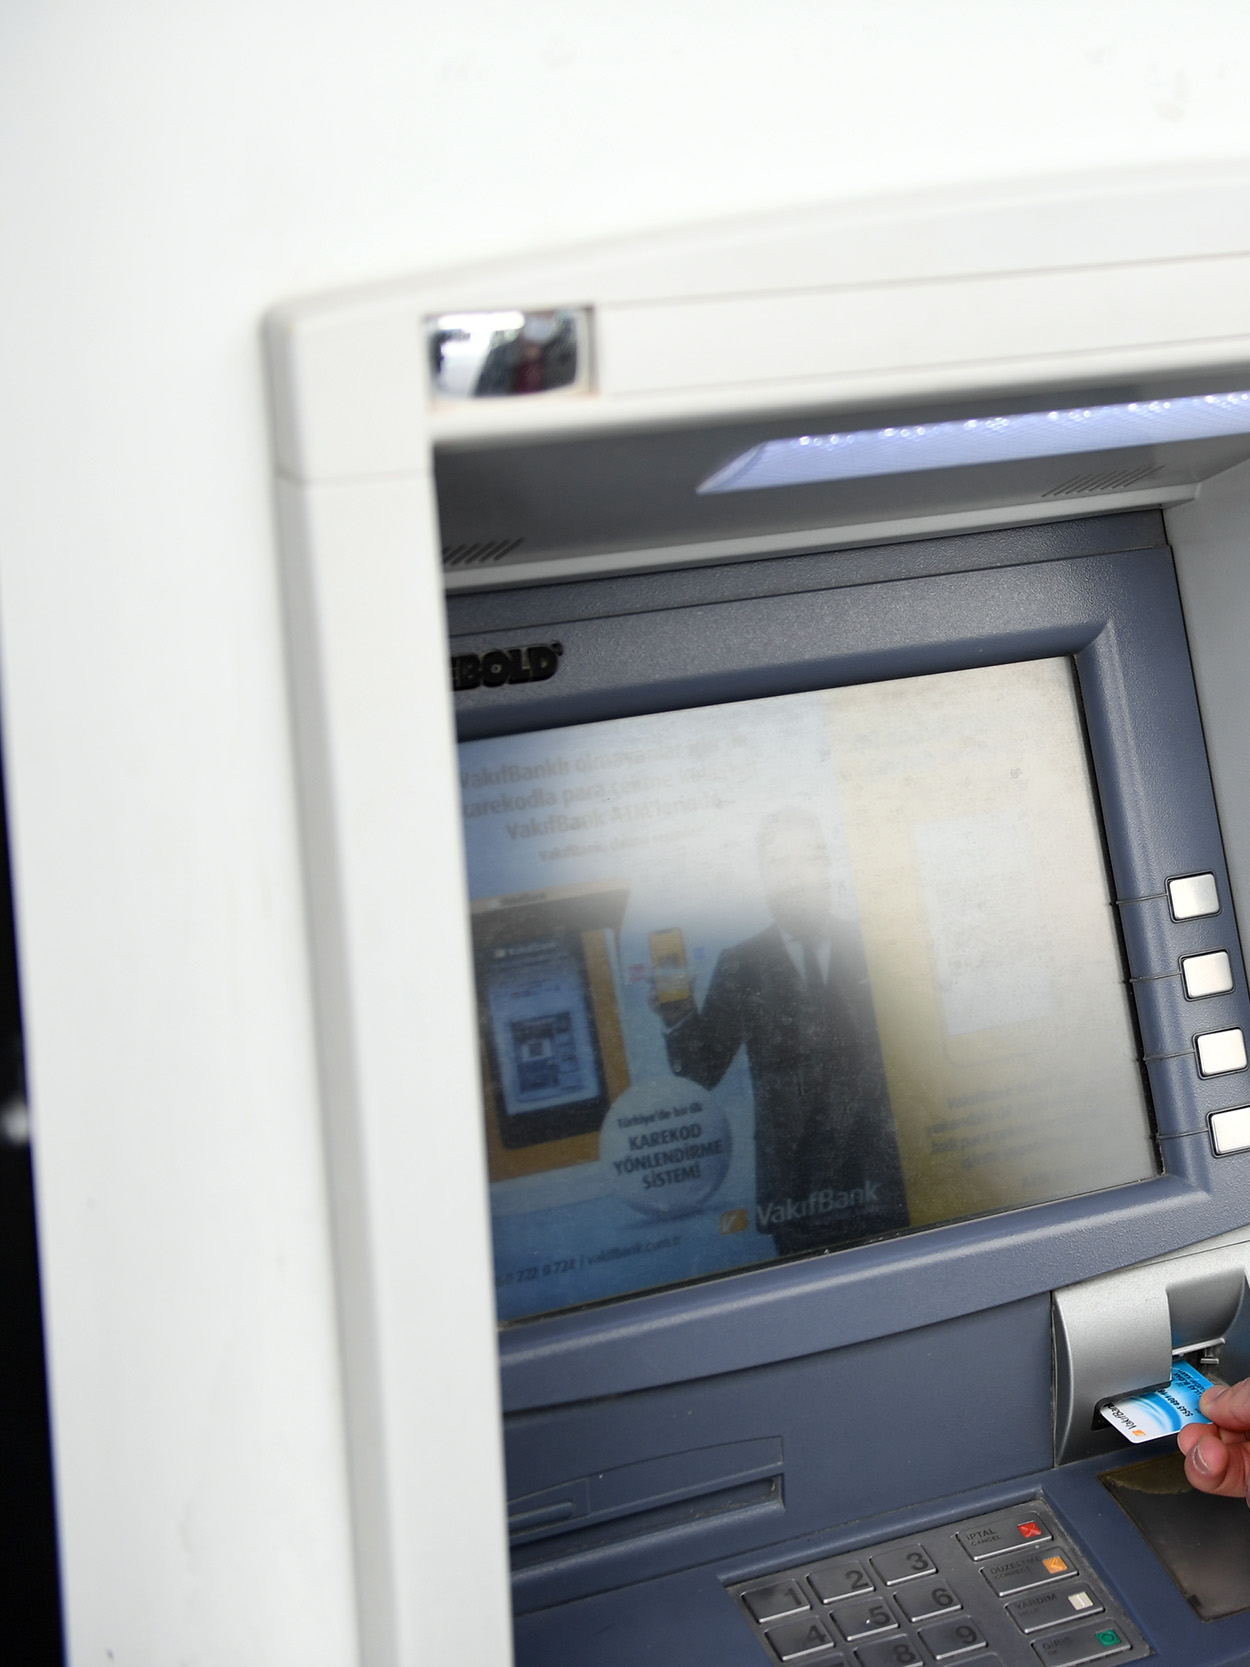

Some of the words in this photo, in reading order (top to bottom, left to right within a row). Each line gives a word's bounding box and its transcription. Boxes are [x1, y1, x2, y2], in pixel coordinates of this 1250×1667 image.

[628, 1123, 702, 1151] KAREKOD
[613, 1137, 723, 1176] YÖNLENDİRME
[757, 1180, 881, 1227] VakıfBank
[906, 1552, 928, 1571] 3
[845, 1570, 869, 1589] 2
[785, 1587, 802, 1606] 1
[931, 1588, 954, 1606] 6
[1015, 1593, 1058, 1610] YARDIM
[869, 1606, 891, 1625] 5
[806, 1625, 826, 1643] 4
[955, 1626, 978, 1645] 9
[896, 1644, 916, 1664] 8
